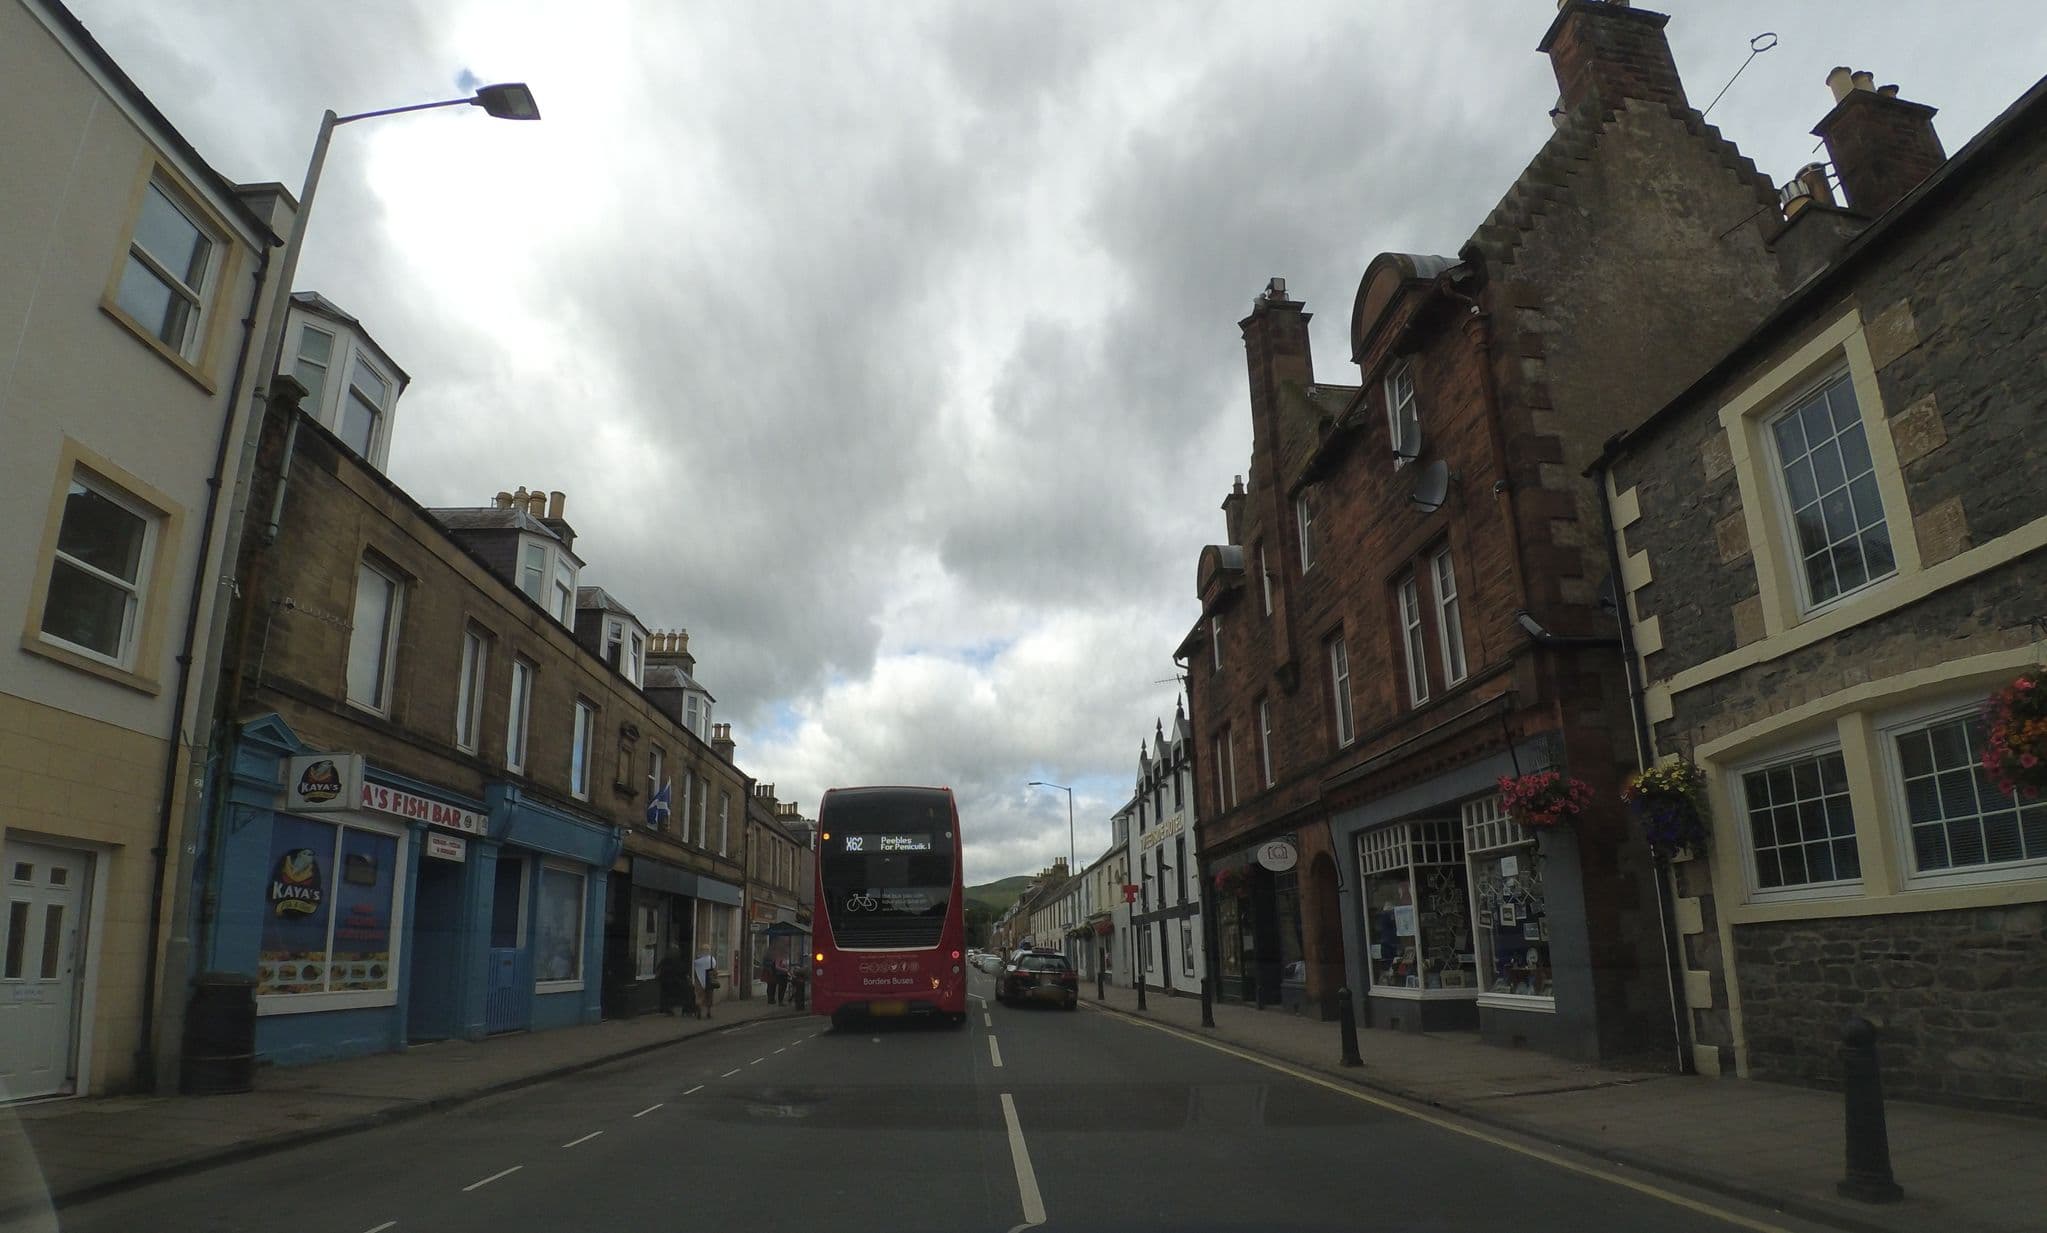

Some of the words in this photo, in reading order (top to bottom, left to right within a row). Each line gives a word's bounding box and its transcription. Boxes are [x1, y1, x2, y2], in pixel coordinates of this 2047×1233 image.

[302, 781, 340, 794] KAYA'S
[393, 792, 429, 820] FISH
[432, 804, 461, 827] BAR
[1165, 815, 1183, 838] HOTEL
[846, 836, 863, 852] X62
[881, 836, 912, 844] Peebles
[272, 880, 320, 901] KAYA'S
[863, 977, 891, 986] Borders
[892, 977, 914, 985] Buses
